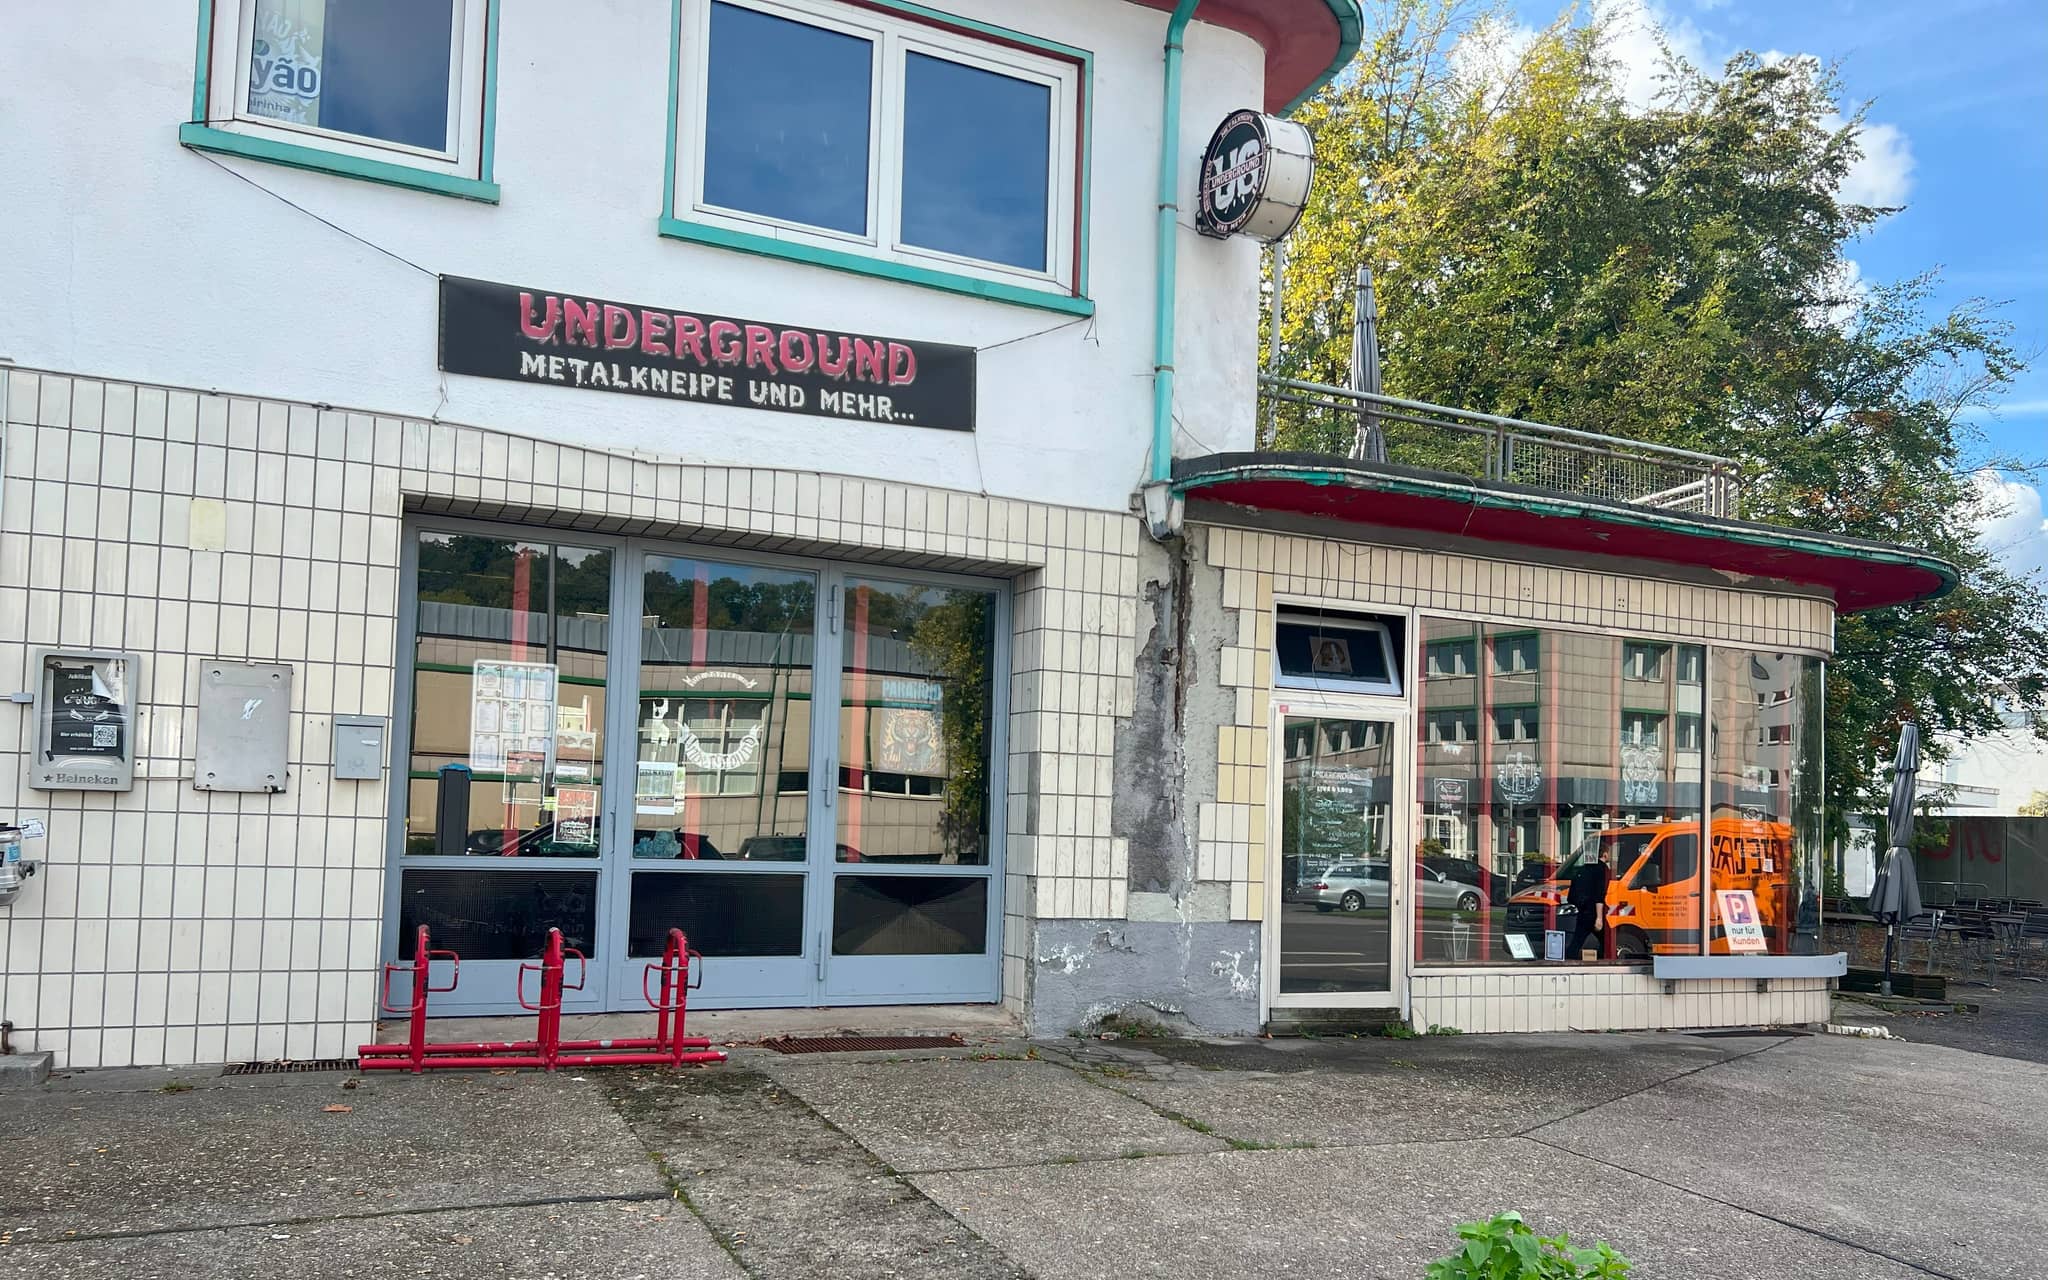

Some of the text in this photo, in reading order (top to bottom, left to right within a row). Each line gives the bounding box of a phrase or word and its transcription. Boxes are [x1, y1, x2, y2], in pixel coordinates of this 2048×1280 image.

[1210, 155, 1261, 189] UNDERGROUND
[518, 292, 917, 385] UNDERGROUND
[520, 351, 916, 421] METALKNEIPE UND MEHR...
[56, 773, 119, 785] Heineken
[1731, 927, 1744, 935] nur
[1733, 936, 1760, 945] Kunden
